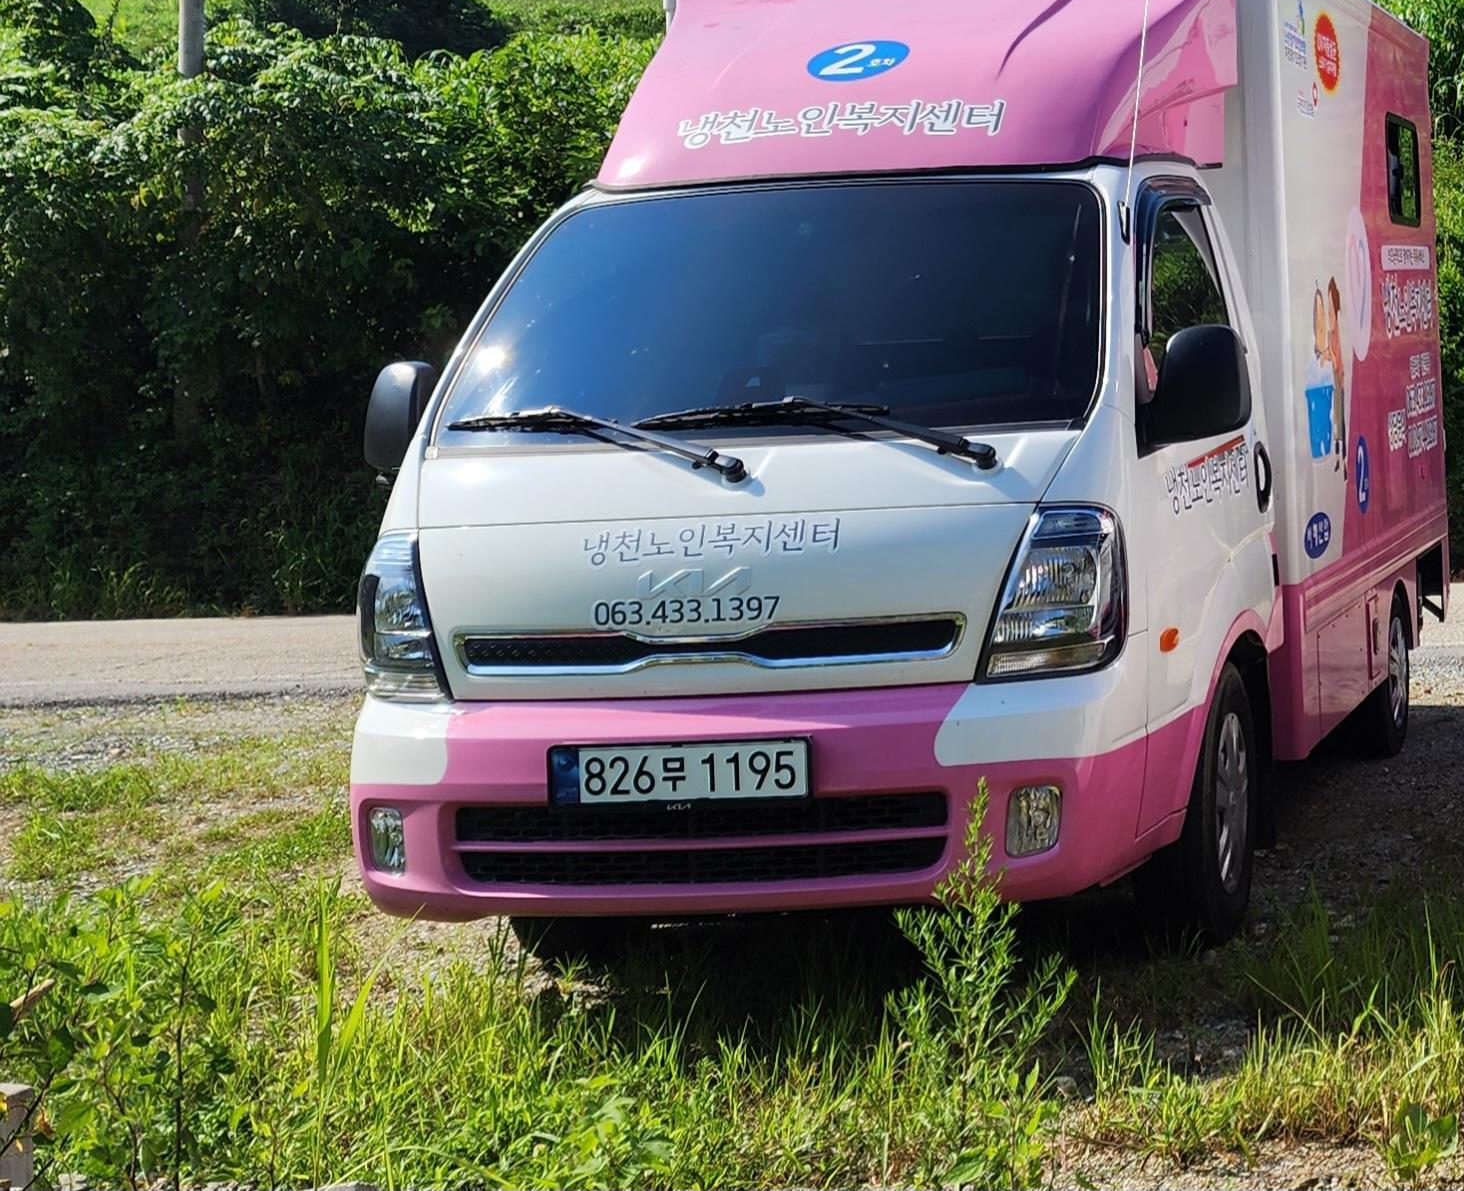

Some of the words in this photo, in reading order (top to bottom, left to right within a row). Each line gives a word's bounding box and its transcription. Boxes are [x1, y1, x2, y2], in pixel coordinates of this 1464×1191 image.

[678, 100, 1004, 148] 냉천노인복지센터
[1163, 454, 1250, 514] 냉천노인복지센터
[583, 517, 841, 567] 냉천노인복지센터
[593, 596, 780, 626] 063.433.1397
[584, 755, 686, 796] 826무
[701, 750, 796, 792] 1195
